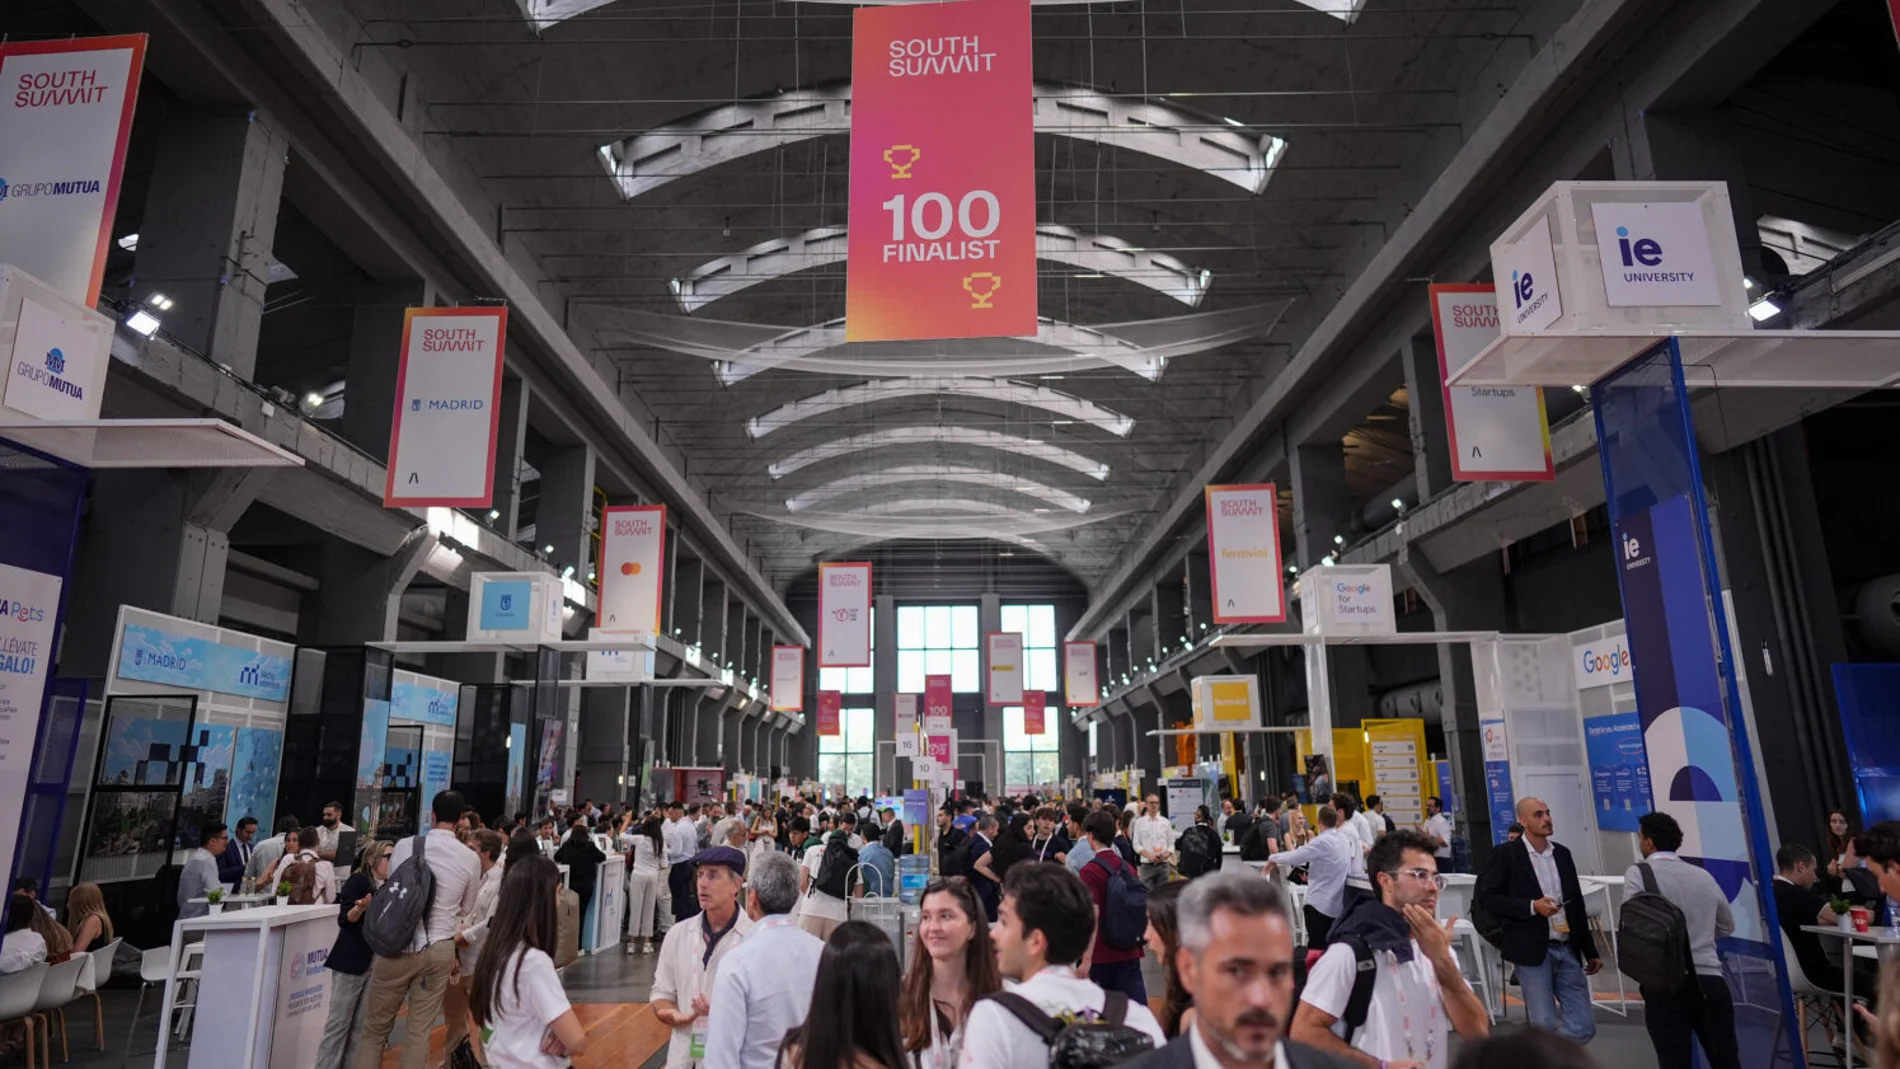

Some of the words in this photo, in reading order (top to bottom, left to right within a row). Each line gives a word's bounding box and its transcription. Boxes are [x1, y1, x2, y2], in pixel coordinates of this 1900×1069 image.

[889, 35, 980, 58] SOUTH
[889, 53, 997, 77] SUMMIT
[18, 70, 97, 90] SOUTH
[15, 86, 108, 107] SUMMIT
[882, 190, 1001, 241] 100
[882, 240, 1001, 263] FINALIST
[1616, 226, 1663, 267] ie
[1623, 272, 1694, 282] UNIVERSITY
[1512, 270, 1534, 309] ie
[1517, 292, 1549, 324] UNIVERSITY
[1454, 316, 1501, 328] SUMM
[423, 329, 476, 340] SOUTH
[422, 340, 485, 352] SUMMIT
[1471, 386, 1516, 398] Startups
[429, 400, 484, 410] MADRID
[1220, 500, 1257, 509] SOUTH
[1220, 507, 1263, 517] SUMMIT
[615, 520, 648, 528] SOUTH
[614, 527, 653, 536] SUMMIT
[1623, 532, 1640, 560] ie
[1221, 547, 1269, 559] ferrovial
[1626, 557, 1651, 570] UNIVERSITY
[1336, 582, 1371, 595] Google
[1338, 595, 1351, 603] for
[0, 600, 8, 615] A
[11, 602, 44, 622] Pets
[1338, 605, 1376, 615] Startups
[148, 653, 186, 670] MADRID
[1583, 644, 1629, 675] Google
[902, 740, 913, 749] 16
[919, 764, 930, 773] 10
